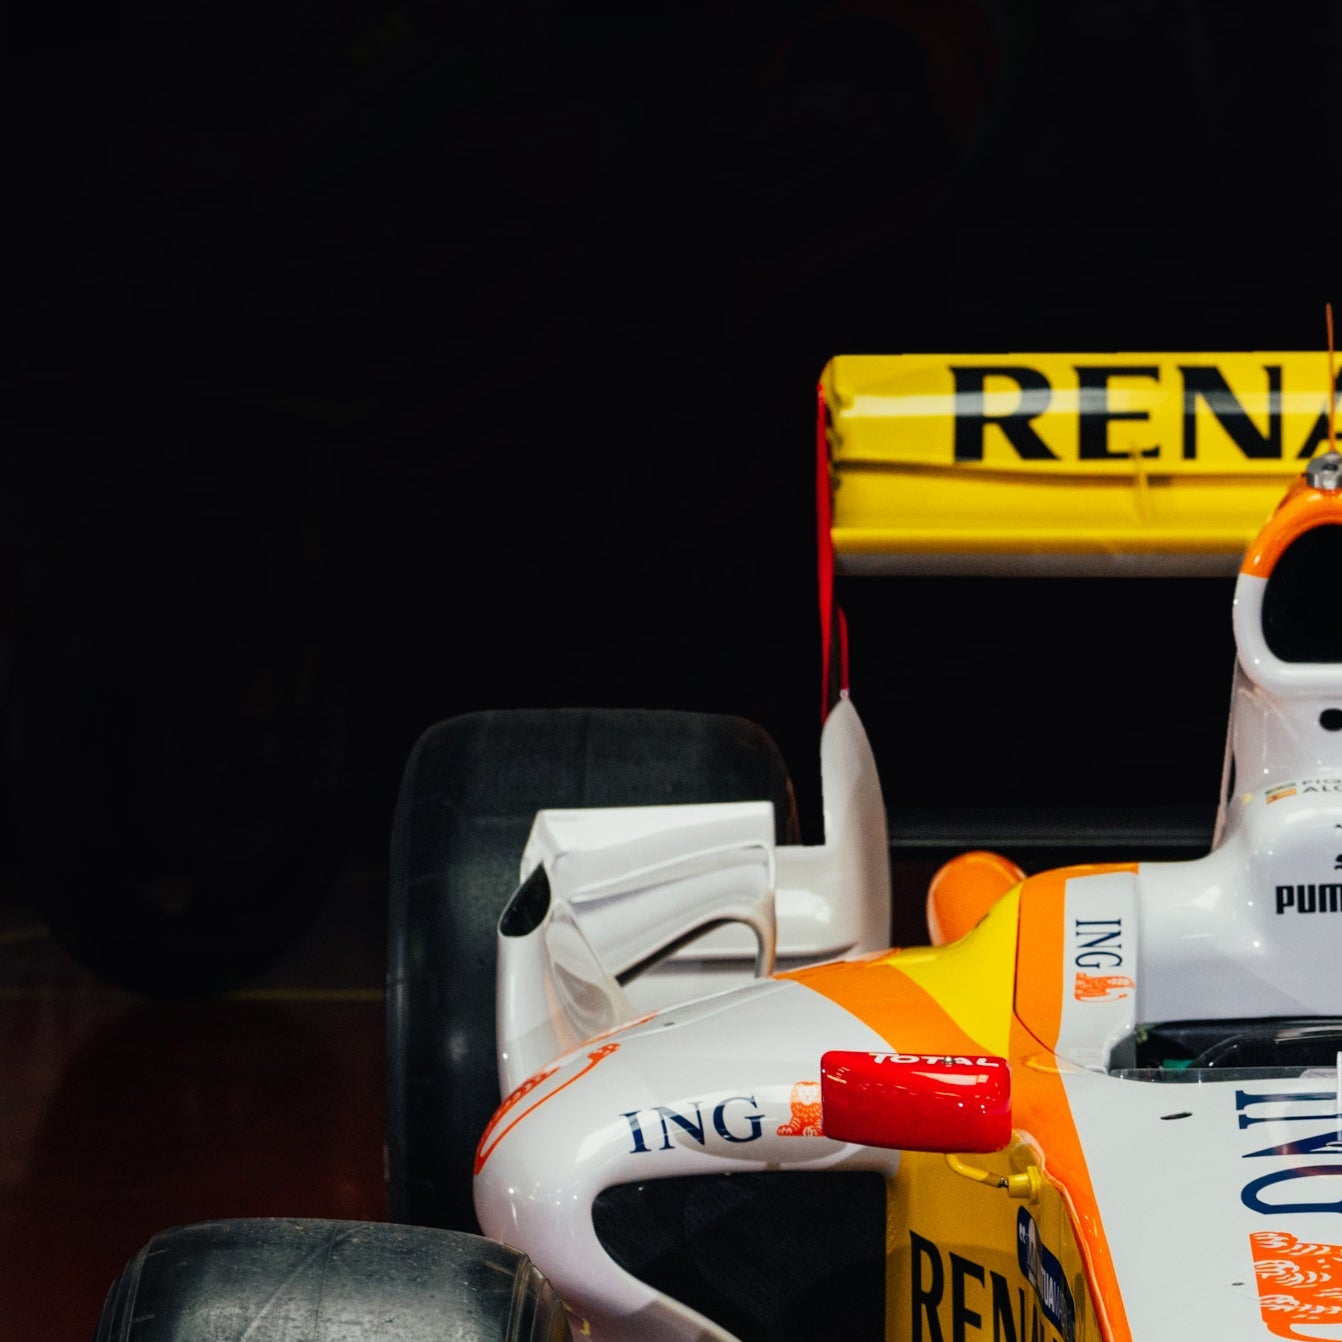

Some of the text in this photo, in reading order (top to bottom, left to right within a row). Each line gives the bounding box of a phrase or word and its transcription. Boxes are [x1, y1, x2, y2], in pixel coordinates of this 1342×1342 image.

[1075, 918, 1123, 969] ING
[868, 1053, 1000, 1068] TOTAL
[619, 1095, 766, 1154] ING
